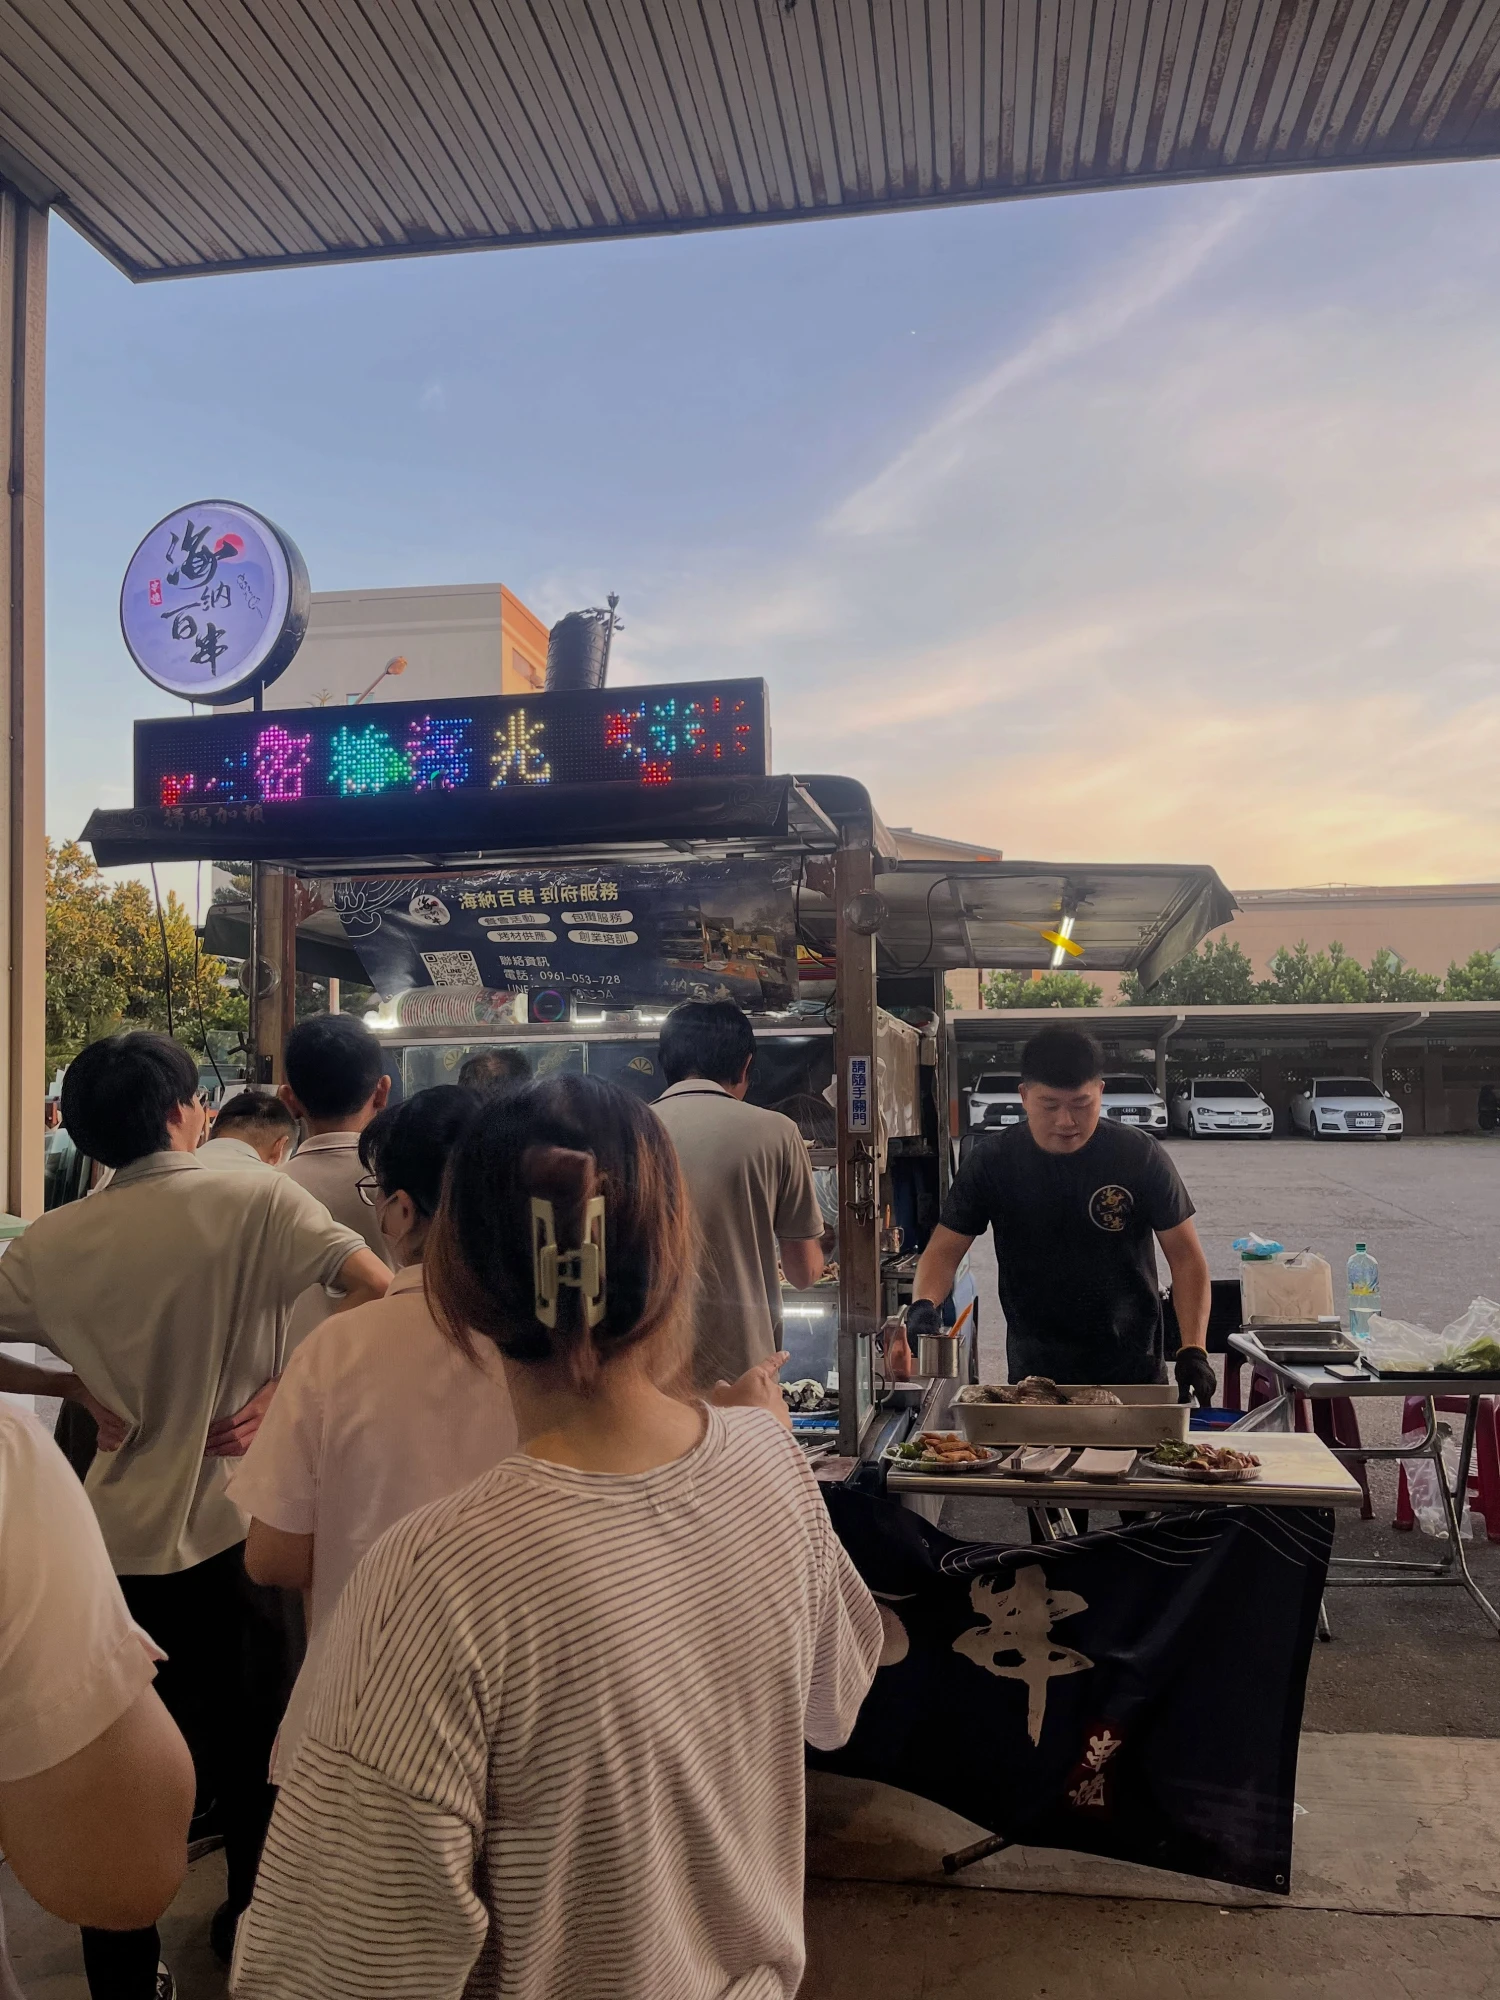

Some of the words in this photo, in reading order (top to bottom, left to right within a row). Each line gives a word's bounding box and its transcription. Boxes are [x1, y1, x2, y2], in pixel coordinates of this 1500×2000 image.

[161, 519, 239, 677] 海納百串
[459, 887, 535, 910] 海納百串
[540, 881, 618, 905] 到府服務
[484, 913, 535, 925] 餐會活動
[572, 911, 623, 923] 包攤服務
[498, 930, 547, 941] 烤材供應
[579, 930, 629, 944] 創業培訓
[499, 955, 550, 967] 聯絡資訊
[539, 970, 621, 984] 0961-053-728
[851, 1060, 867, 1126] 請隨手關門
[1069, 1729, 1122, 1808] 串燒
